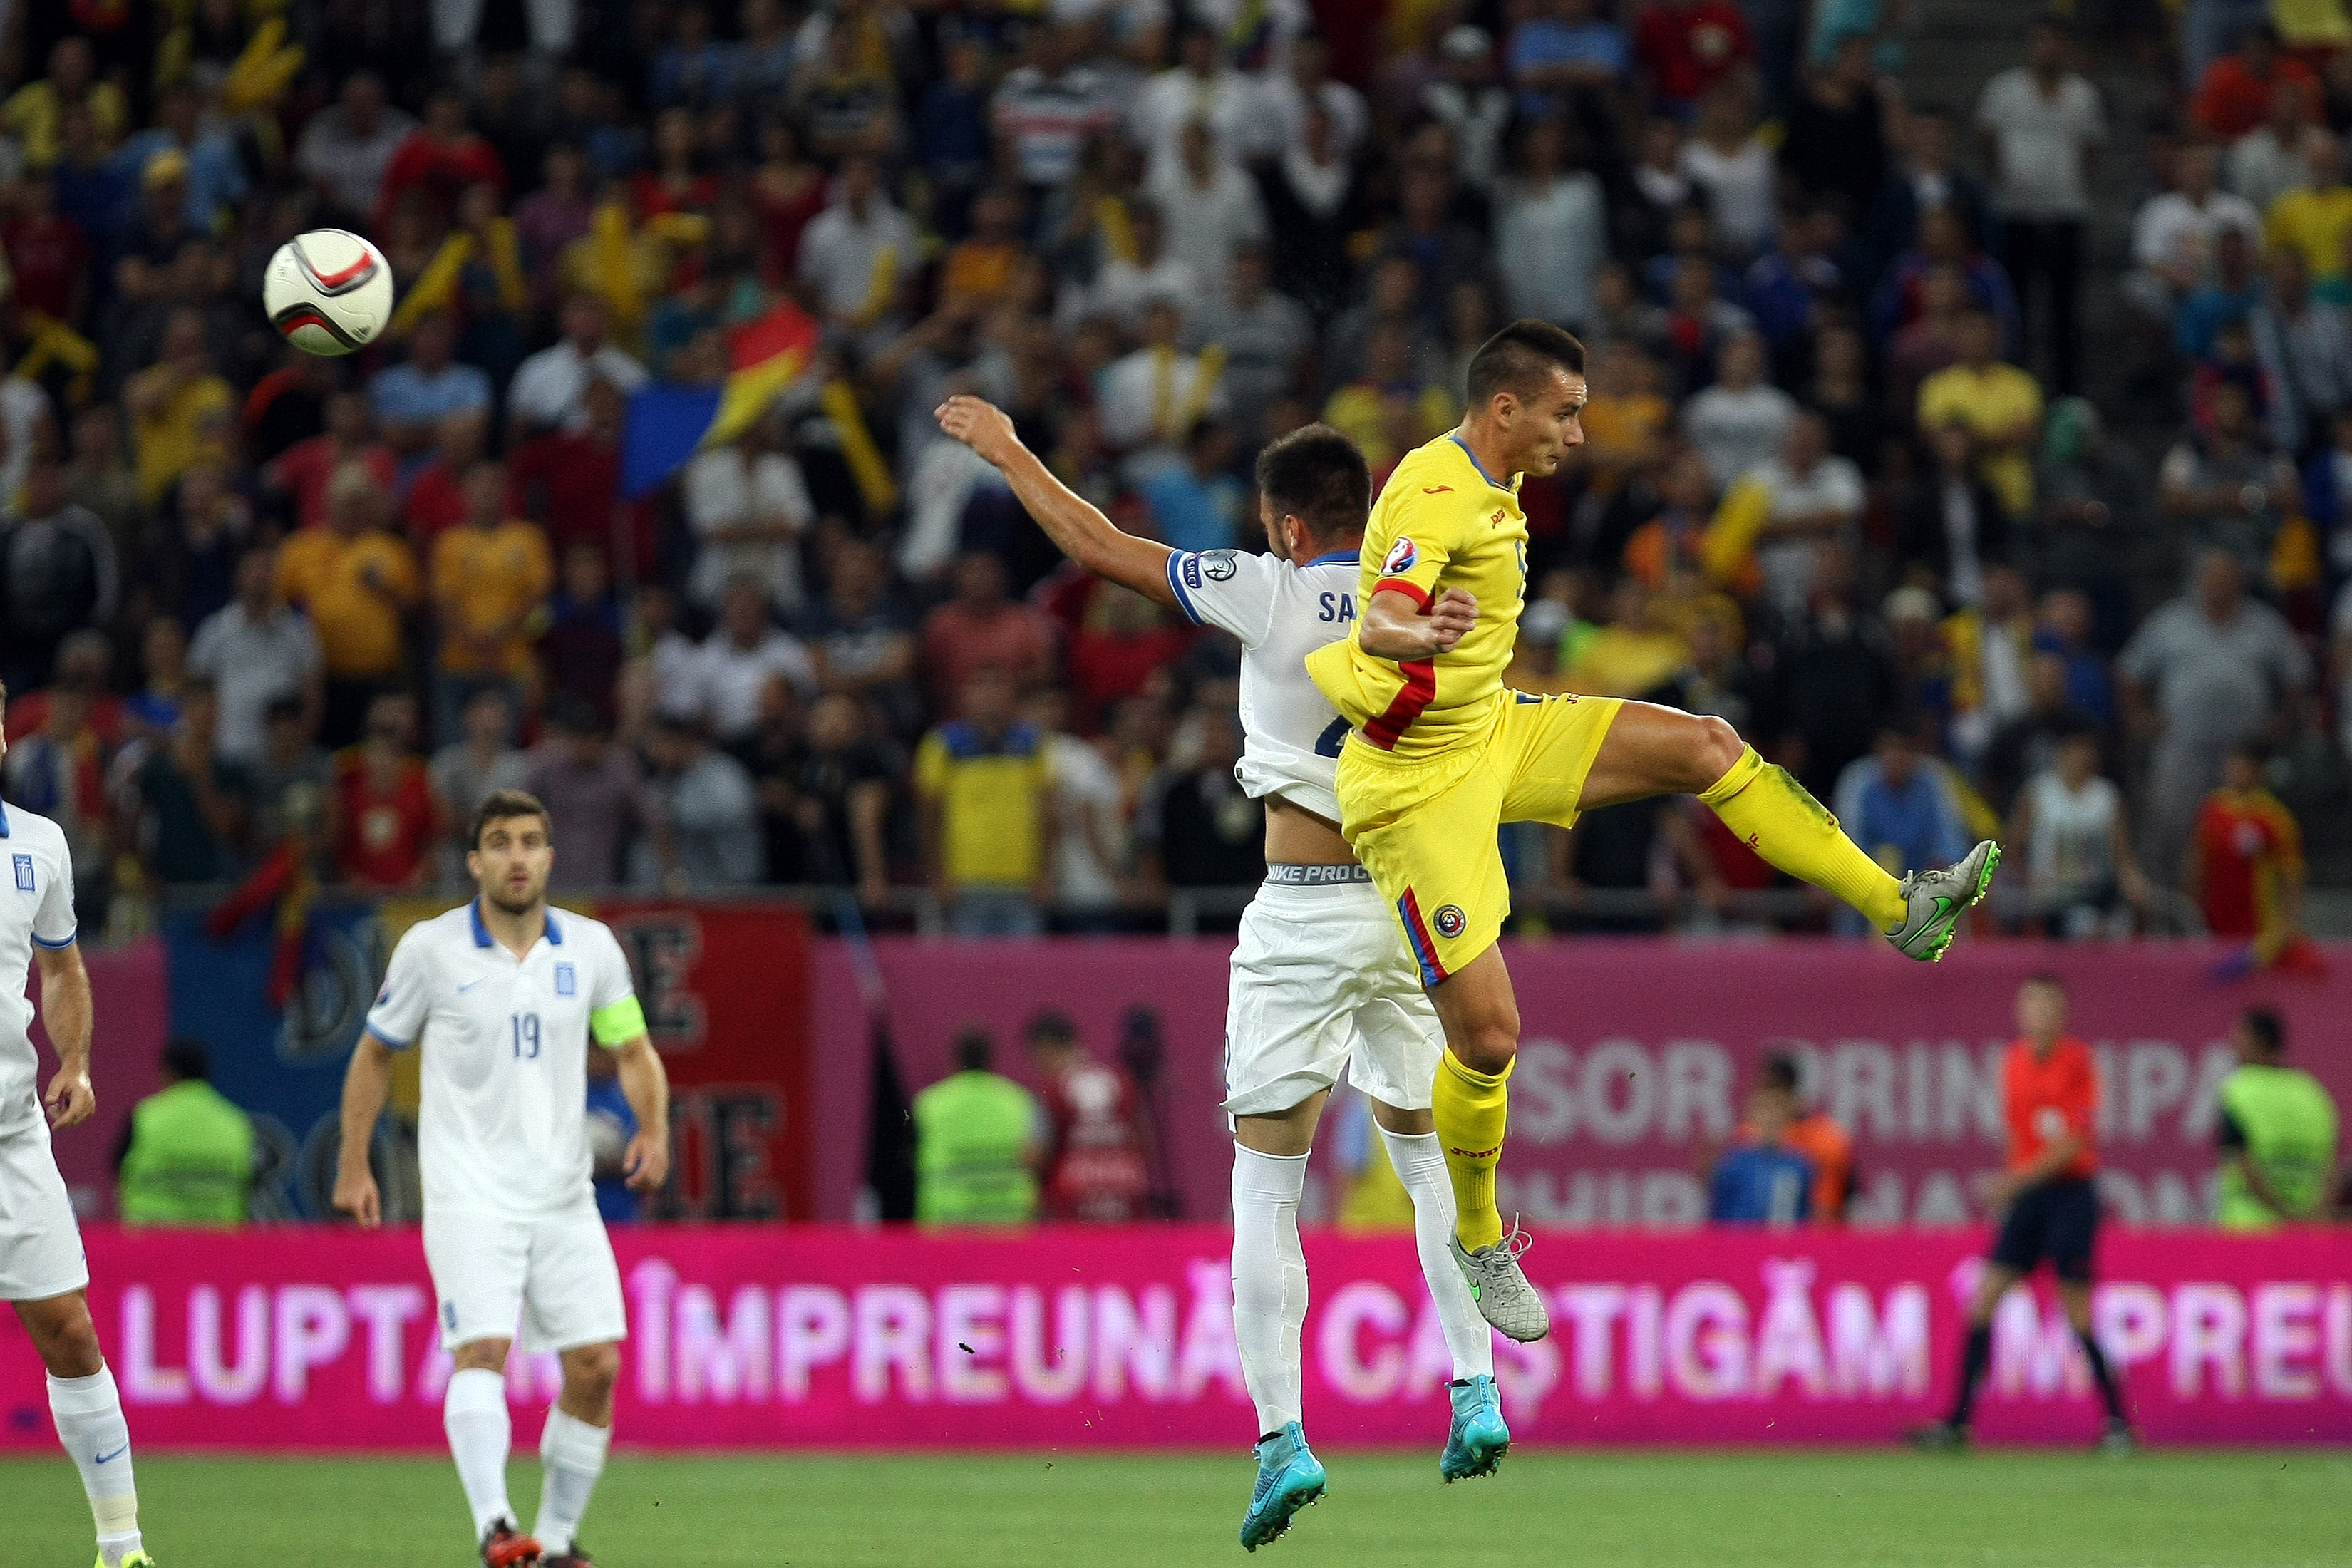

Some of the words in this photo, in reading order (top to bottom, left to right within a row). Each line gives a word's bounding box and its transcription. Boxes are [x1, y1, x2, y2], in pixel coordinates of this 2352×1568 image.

[1186, 557, 1198, 588] SPECT
[1319, 591, 1358, 623] SA
[1268, 864, 1303, 882] NIKE
[1304, 864, 1350, 882] PRO
[511, 1013, 540, 1059] 19
